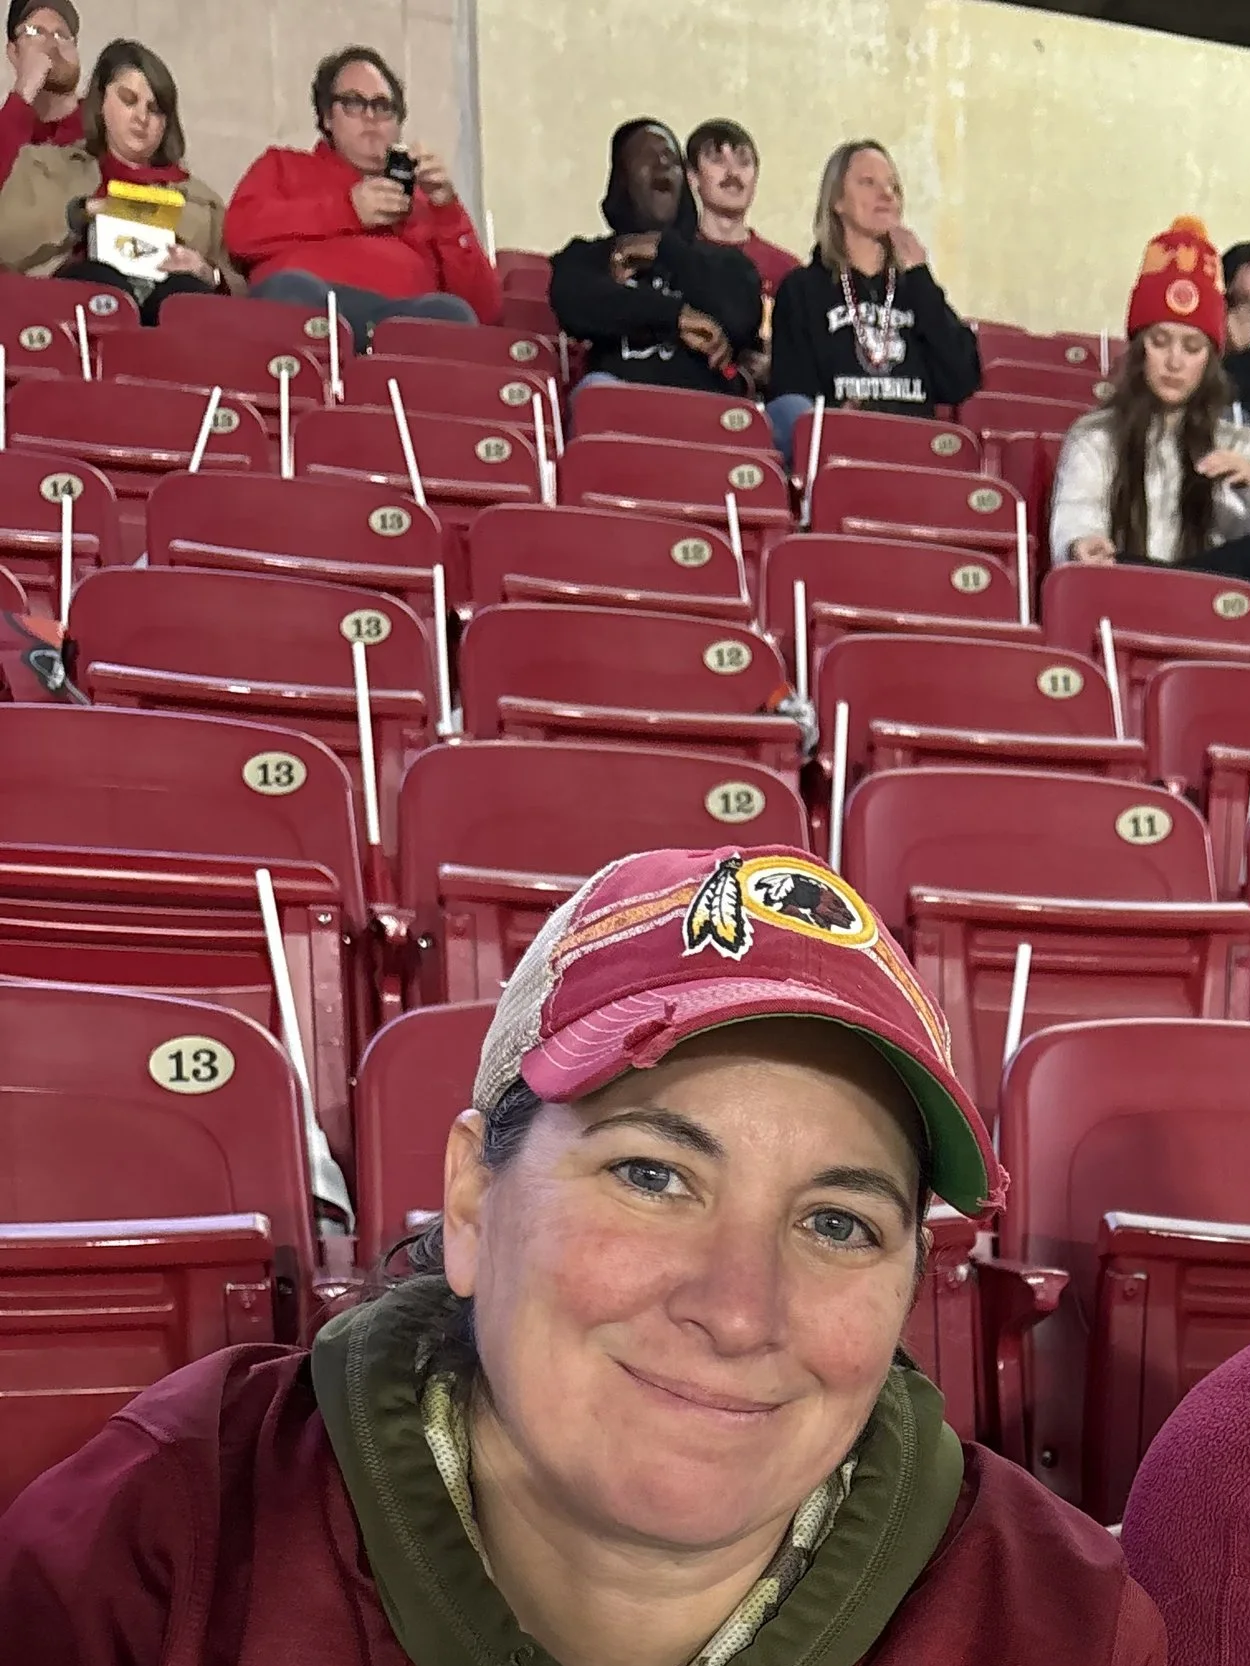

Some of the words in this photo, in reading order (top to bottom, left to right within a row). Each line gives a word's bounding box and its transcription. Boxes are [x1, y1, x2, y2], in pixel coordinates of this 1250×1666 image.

[52, 479, 73, 497] 14
[353, 616, 381, 637] 13
[716, 647, 744, 668] 12
[1050, 674, 1071, 693] 11
[256, 761, 294, 787] 13
[719, 790, 754, 815] 12
[1130, 815, 1158, 837] 11
[168, 1048, 219, 1083] 13
